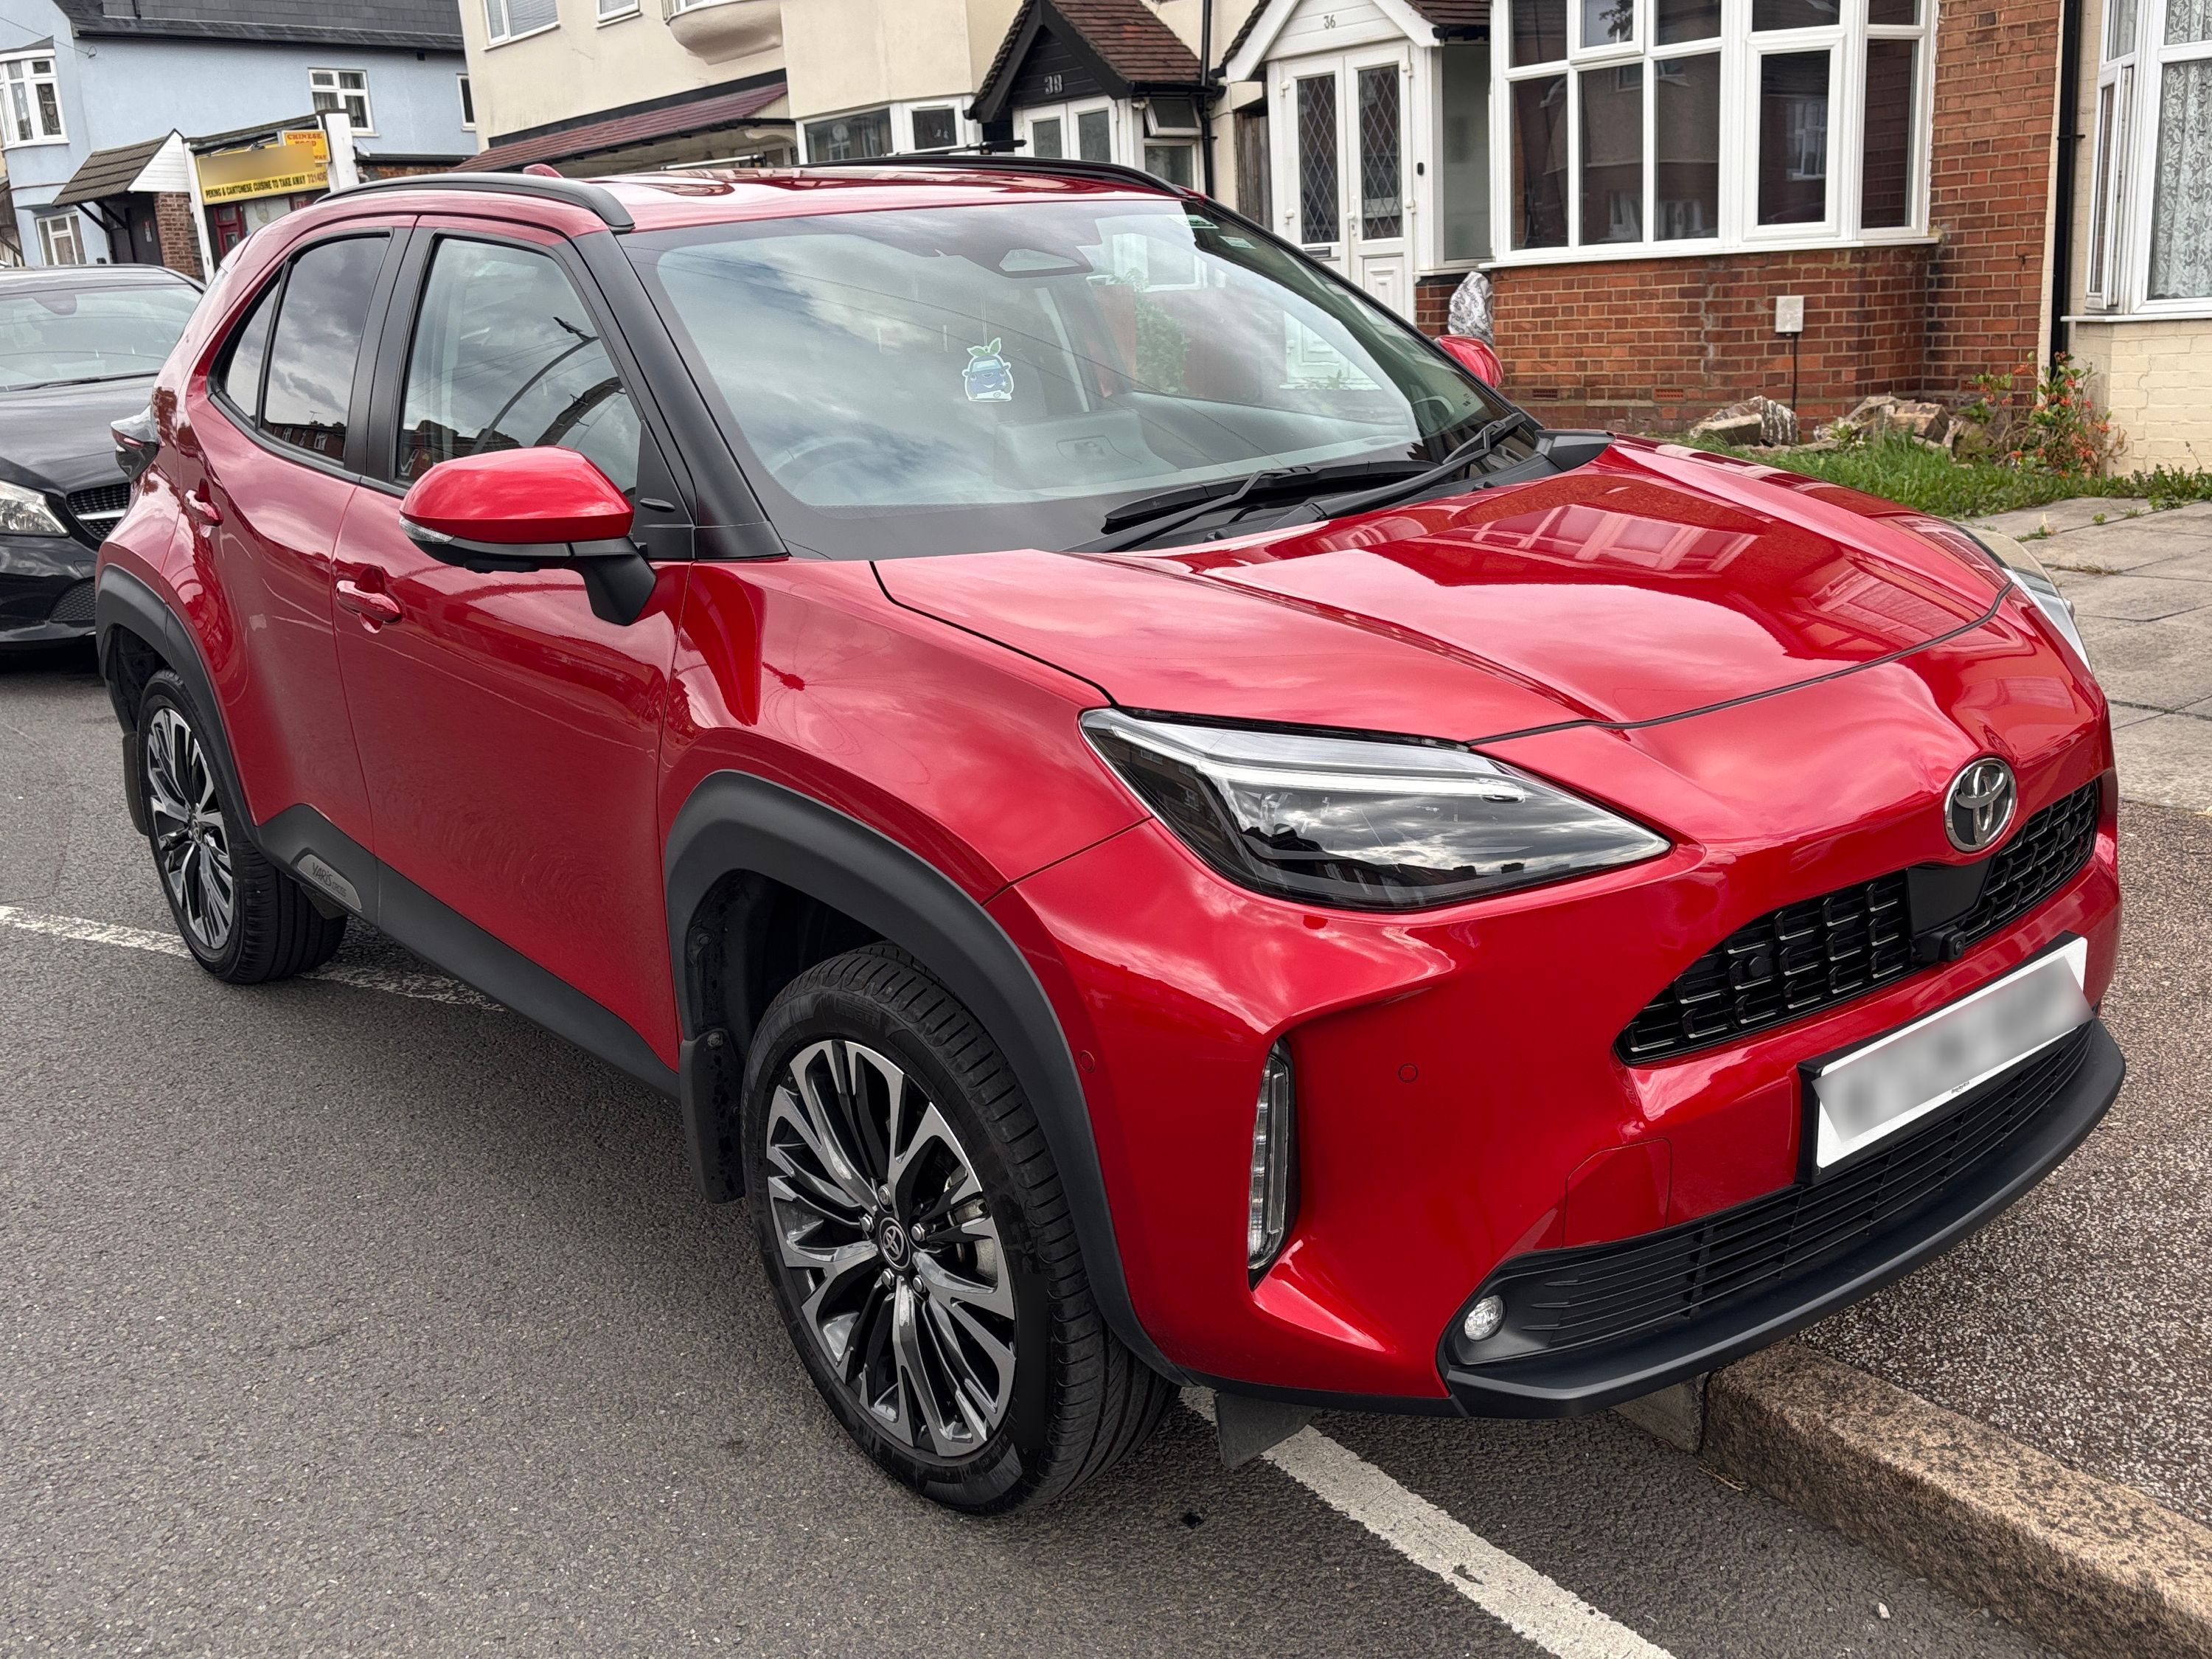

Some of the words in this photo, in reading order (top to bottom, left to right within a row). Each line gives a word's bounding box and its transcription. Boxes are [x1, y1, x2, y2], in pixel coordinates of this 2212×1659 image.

[1324, 14, 1336, 29] 36
[1044, 74, 1063, 95] 38
[205, 187, 222, 199] PEKING
[226, 183, 253, 195] CANTONESE
[253, 180, 272, 192] CUISINE
[271, 178, 279, 189] TO
[279, 177, 292, 187] TAKE
[292, 175, 306, 185] AWAY
